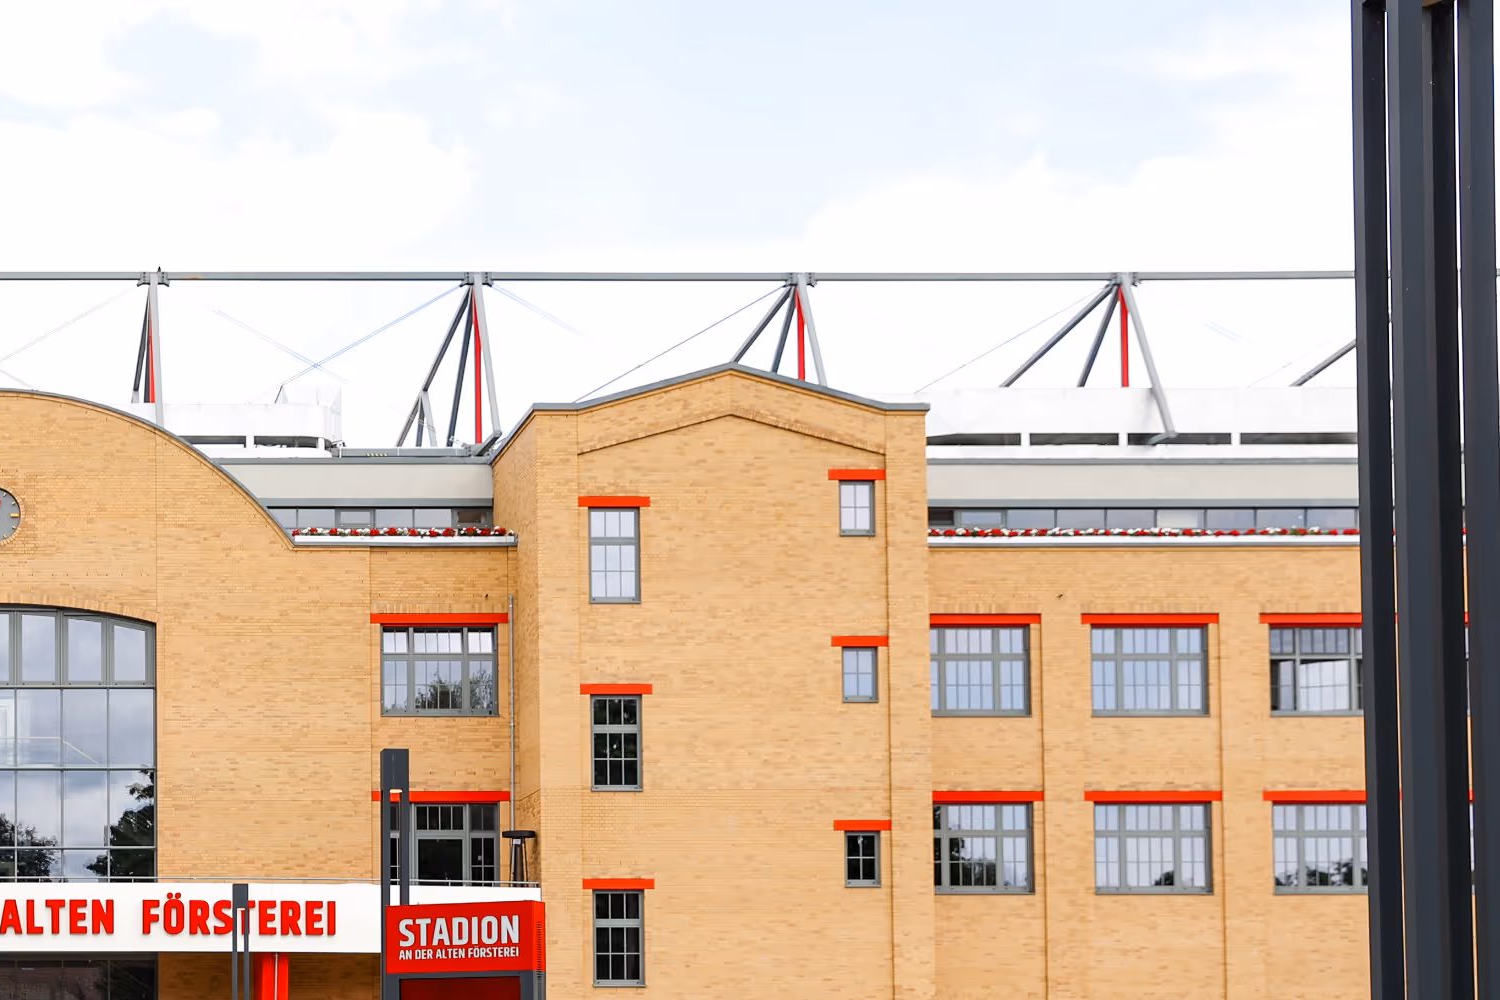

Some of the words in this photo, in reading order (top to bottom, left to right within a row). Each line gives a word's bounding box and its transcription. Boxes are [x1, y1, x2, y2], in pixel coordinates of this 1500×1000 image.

[0, 899, 115, 935] ALTEN
[398, 915, 519, 947] STADION
[398, 949, 413, 961] AN
[414, 948, 434, 960] DER
[435, 947, 466, 959] ALTEN
[467, 945, 519, 957] FÖRSTEREI
